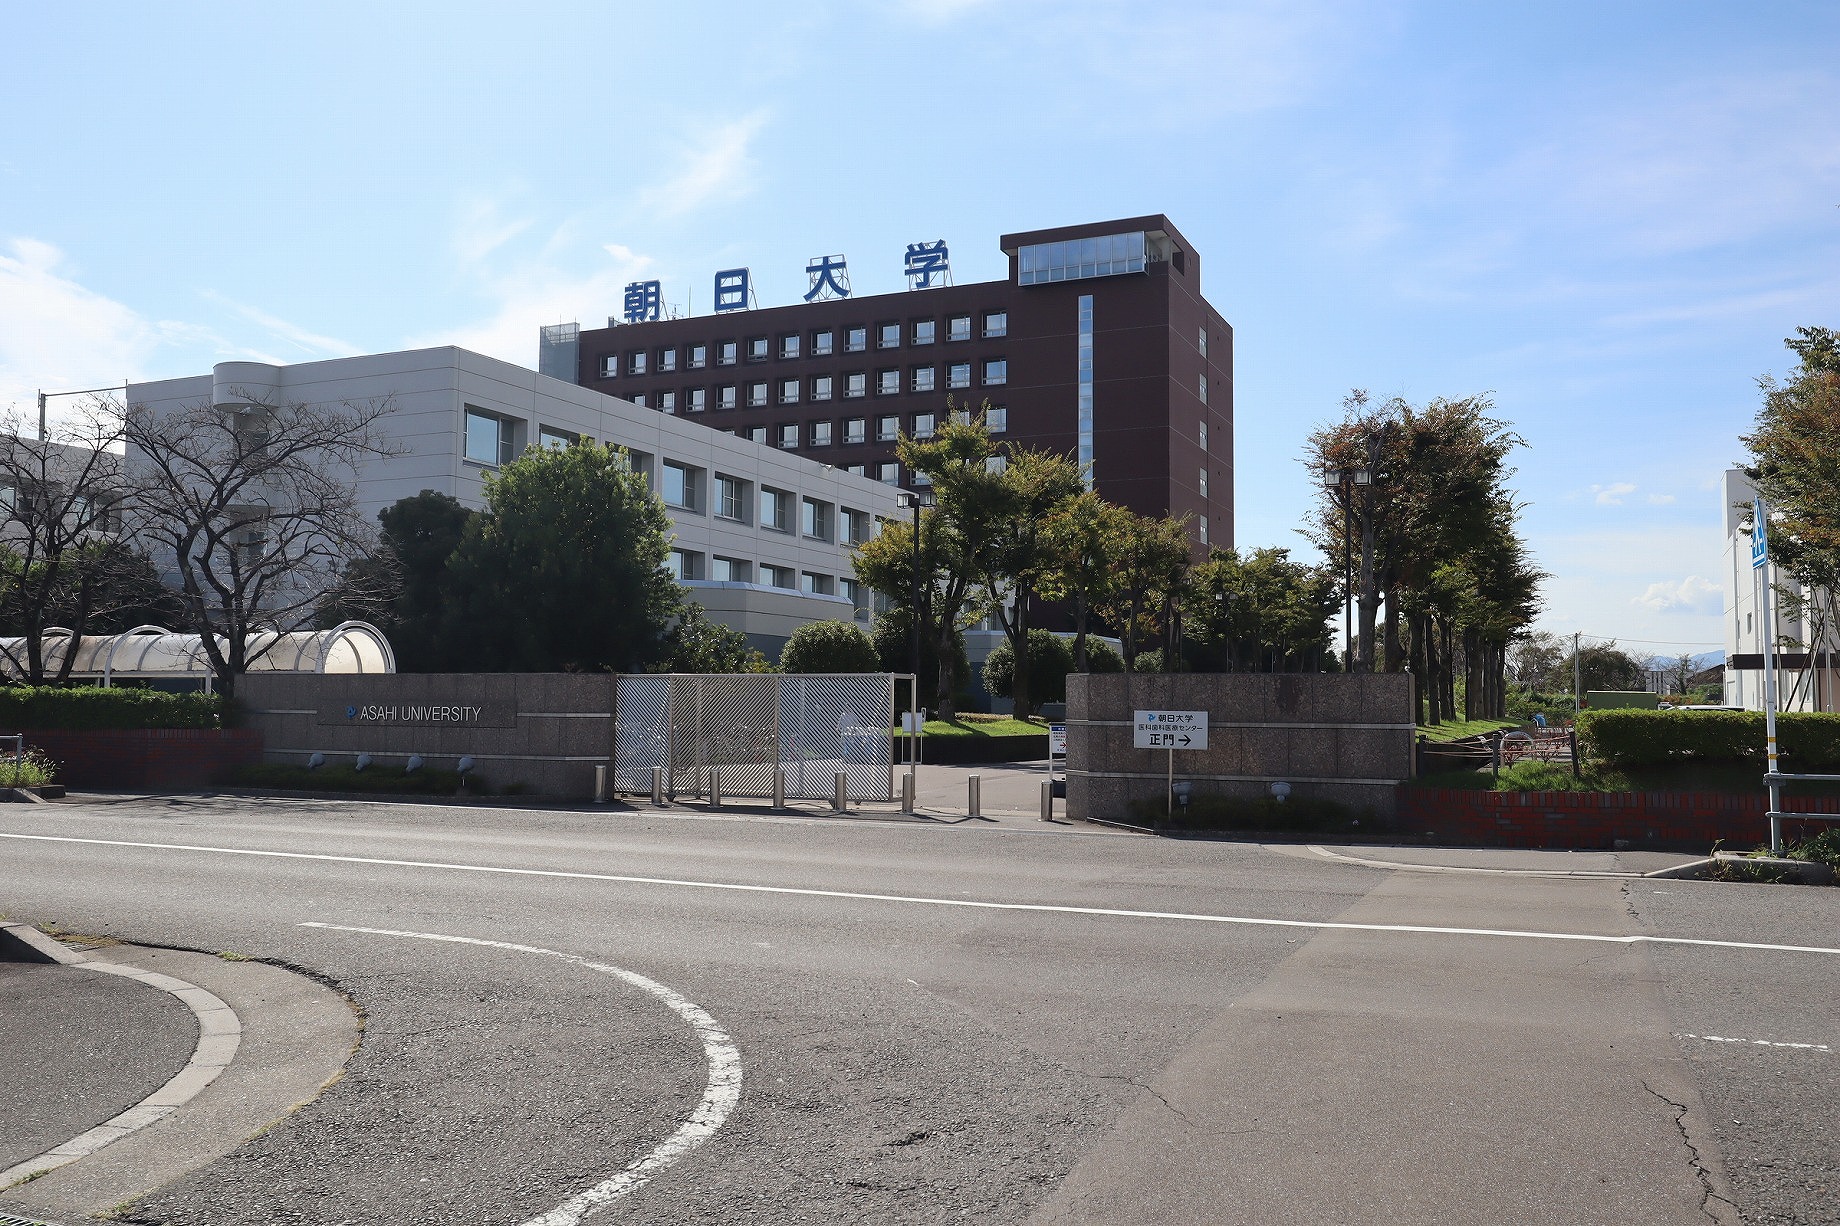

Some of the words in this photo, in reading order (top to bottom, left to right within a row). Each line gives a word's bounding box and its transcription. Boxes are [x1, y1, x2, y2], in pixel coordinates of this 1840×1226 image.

[624, 239, 948, 323] 朝日大学
[360, 705, 397, 721] ASAHI
[401, 705, 482, 722] UNIVERSITY
[1158, 714, 1194, 723] 朝日大学
[1138, 723, 1203, 732] 医科歯科医療センター
[1149, 733, 1175, 746] 正門
